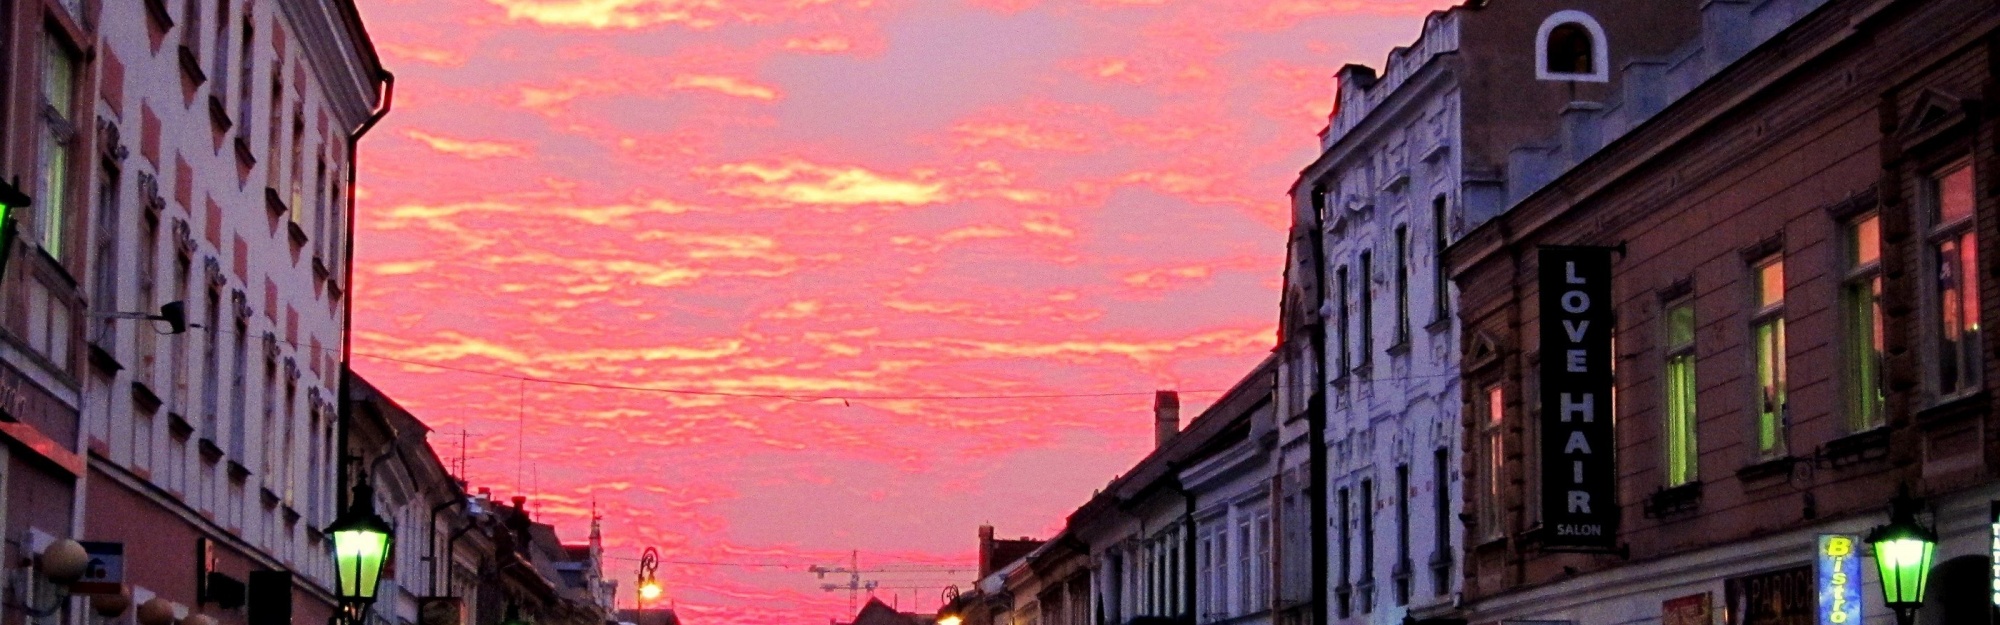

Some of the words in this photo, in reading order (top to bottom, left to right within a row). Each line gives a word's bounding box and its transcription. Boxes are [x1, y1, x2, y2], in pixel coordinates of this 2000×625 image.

[1561, 261, 1590, 372] LOVE
[1560, 392, 1594, 514] HAIR
[1557, 523, 1601, 536] SALON
[1828, 537, 1852, 624] Bistro
